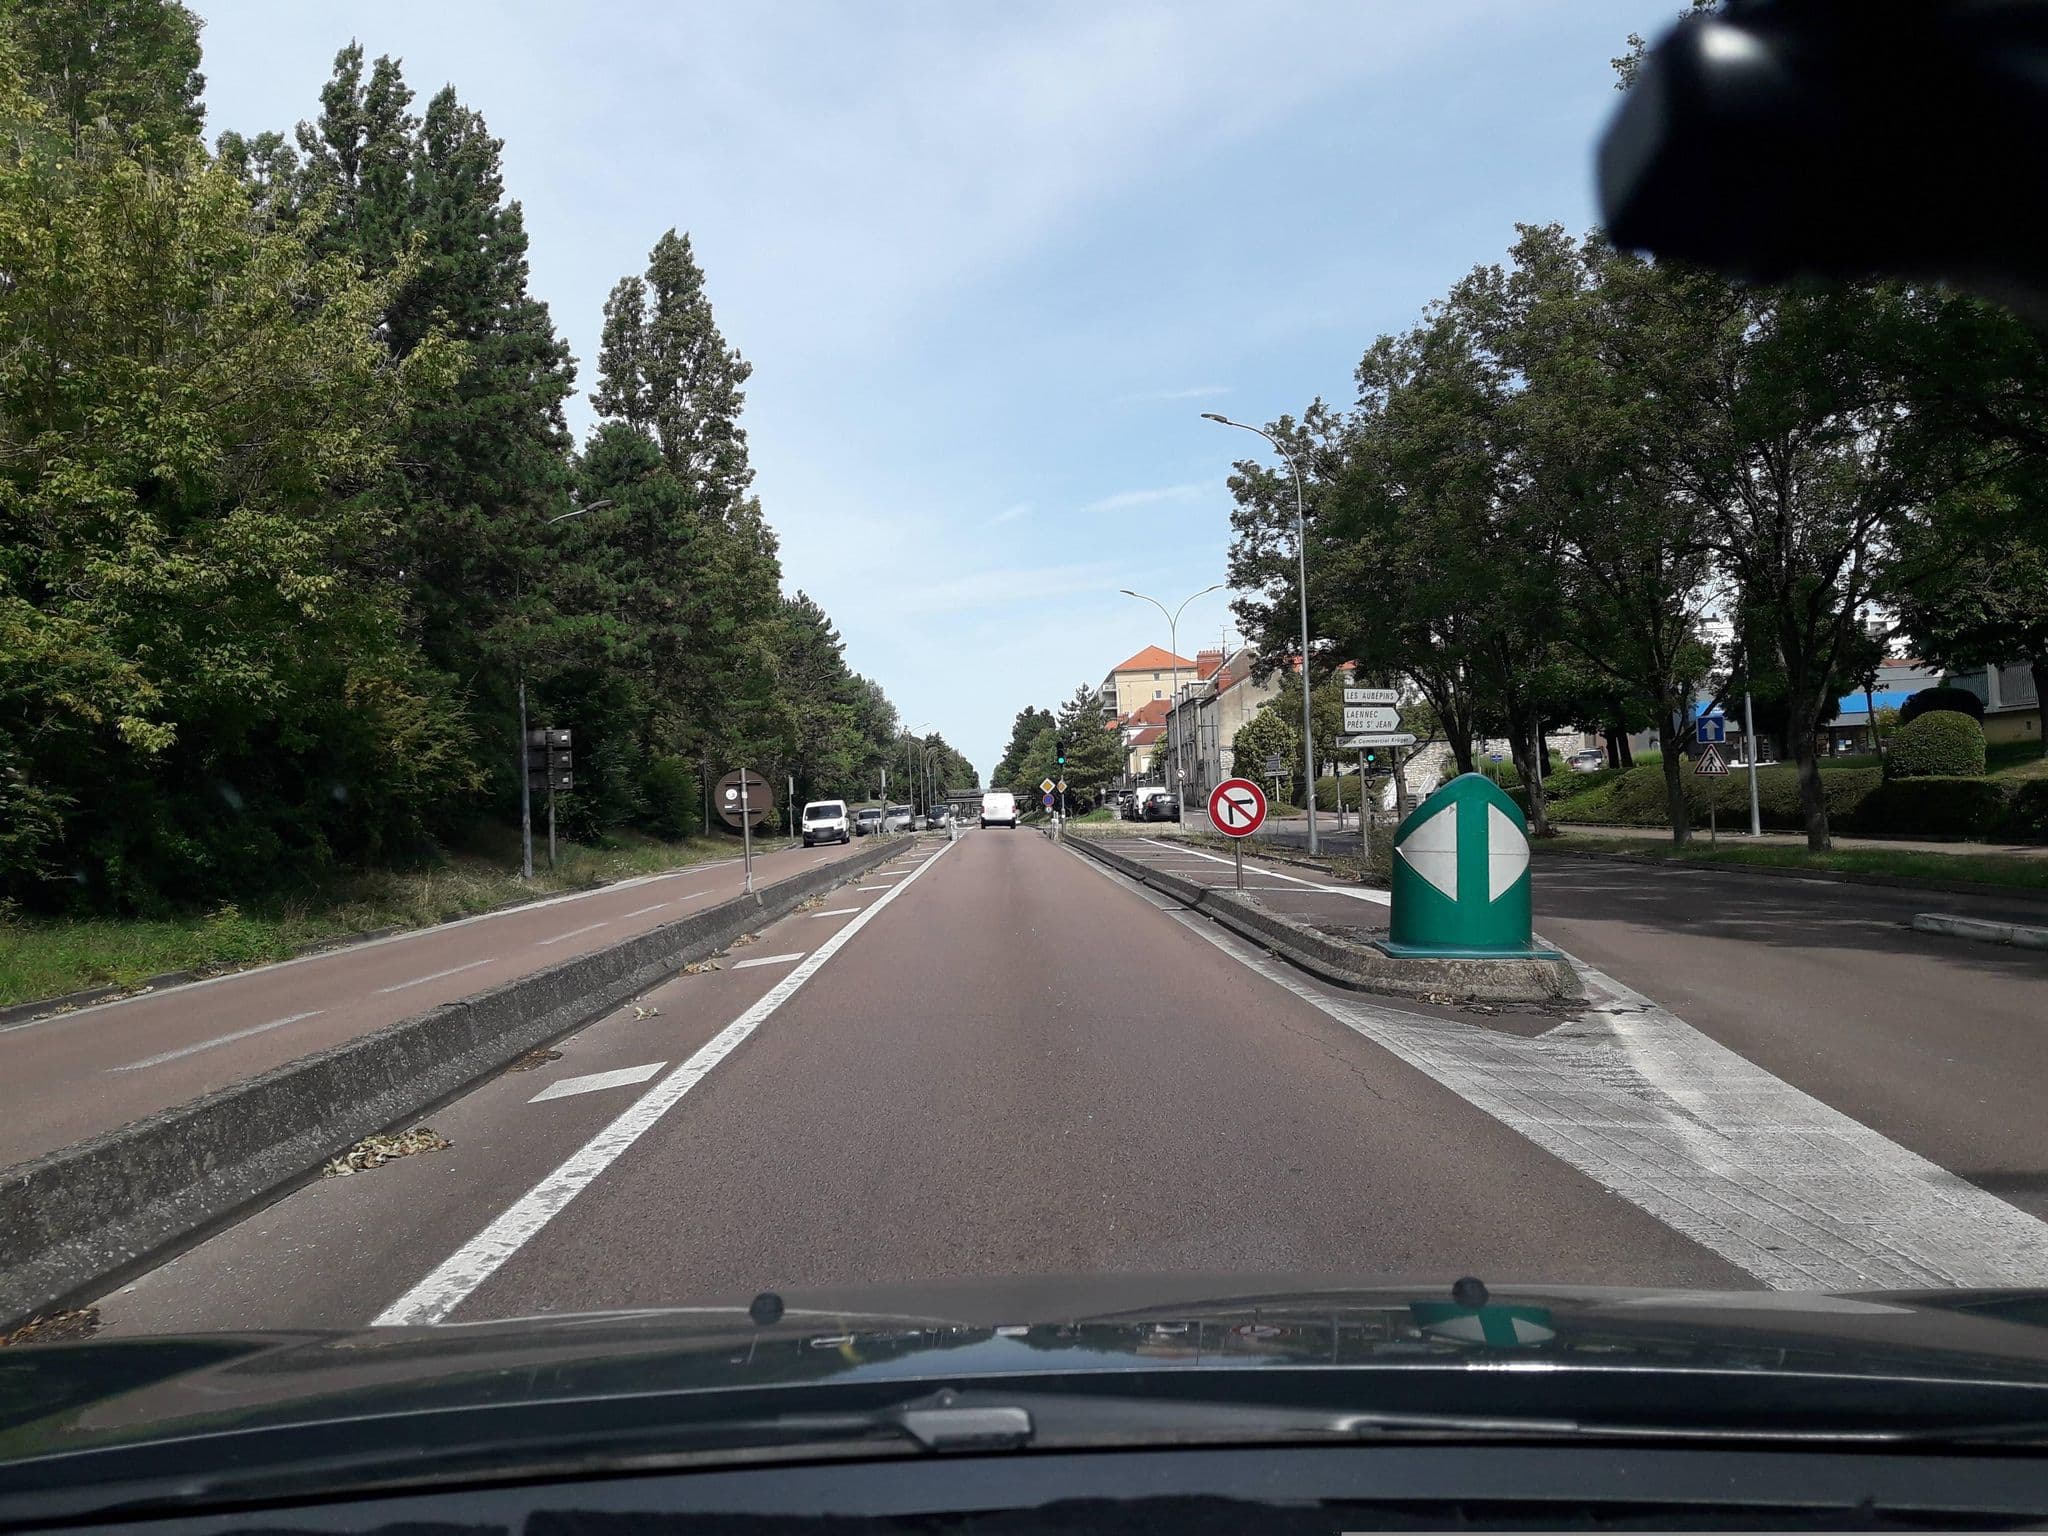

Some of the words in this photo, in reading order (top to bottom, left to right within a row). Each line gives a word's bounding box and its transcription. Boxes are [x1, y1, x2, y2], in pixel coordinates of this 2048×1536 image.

[1362, 691, 1394, 699] AUBÉPINS
[1346, 710, 1379, 718] LAENNEC
[1375, 720, 1392, 728] JEAN
